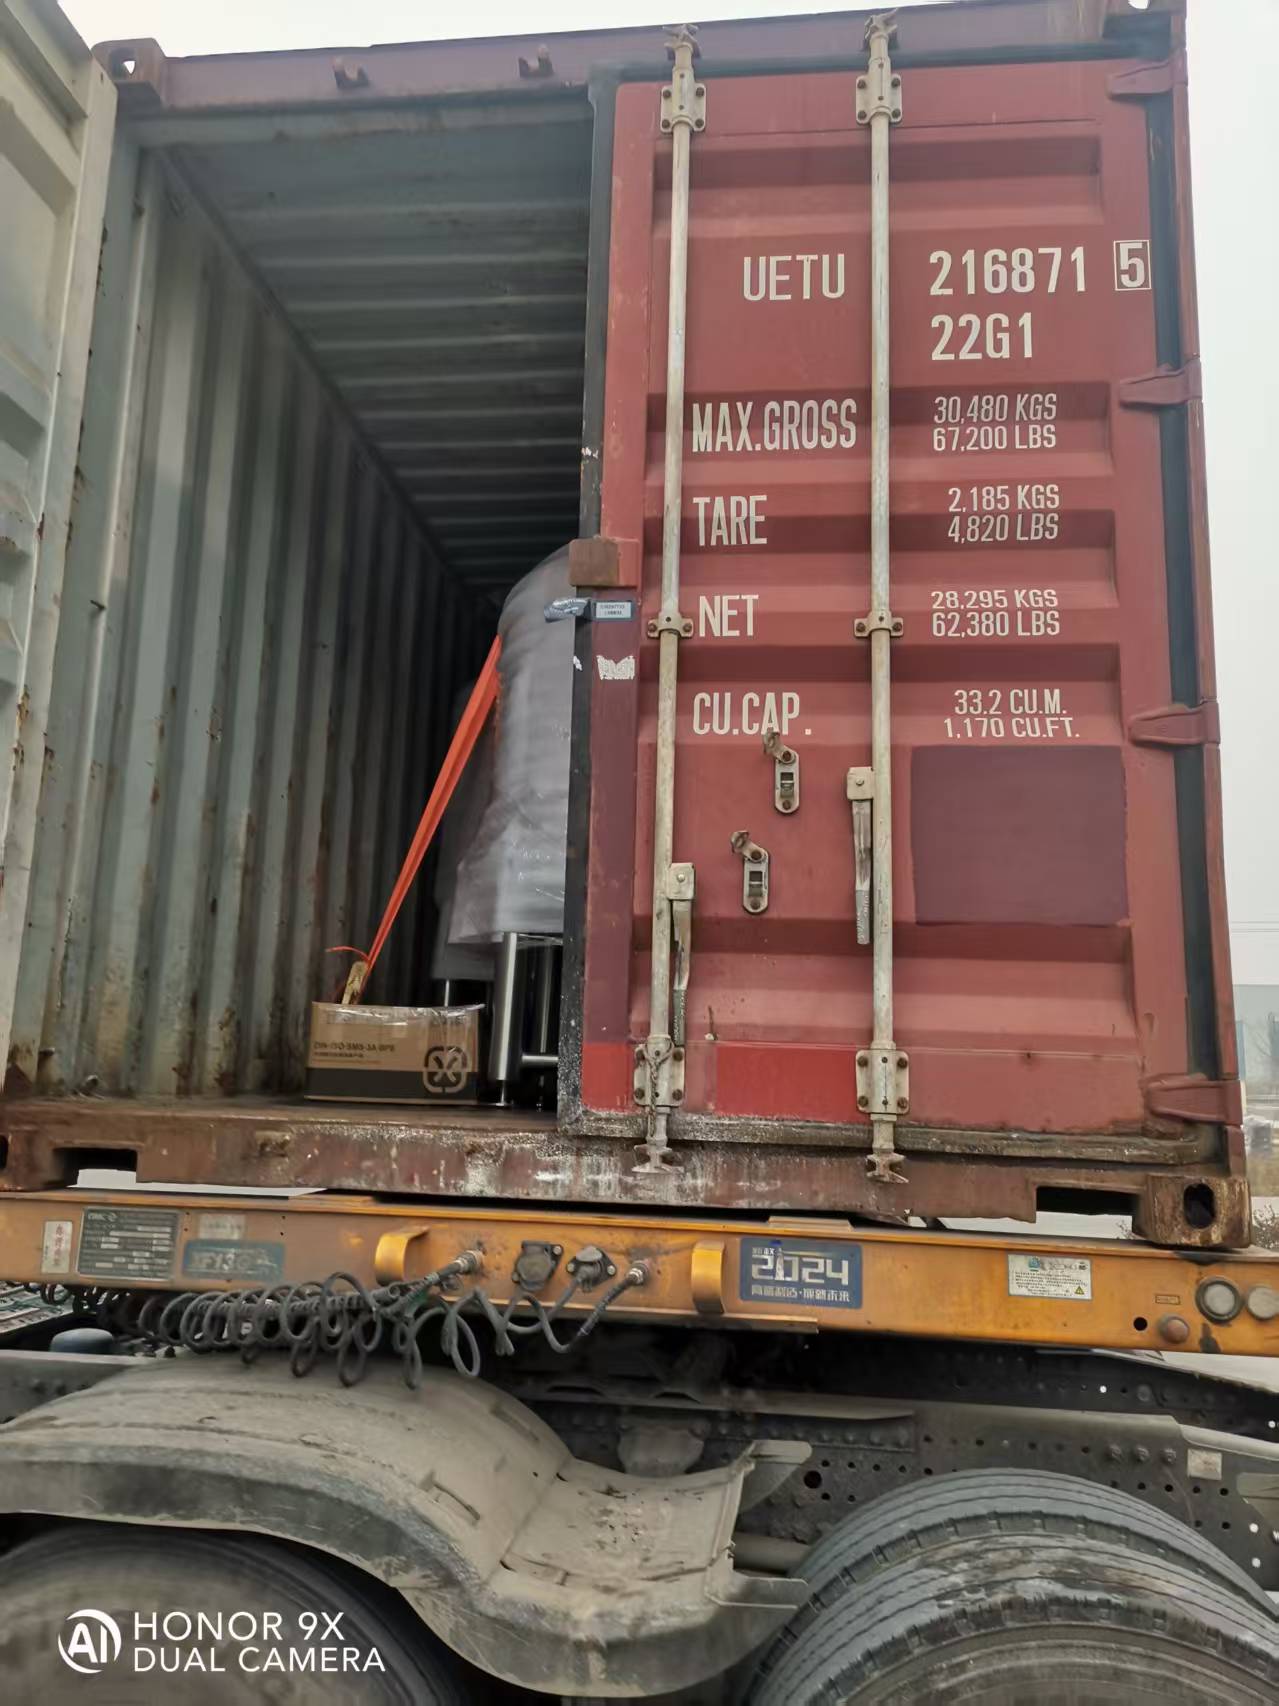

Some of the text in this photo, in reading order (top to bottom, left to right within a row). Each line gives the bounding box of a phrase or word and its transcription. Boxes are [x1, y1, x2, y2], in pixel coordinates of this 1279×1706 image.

[743, 243, 1145, 300] UETU 216871 5
[931, 313, 1032, 361] 22G1
[692, 394, 1057, 452] MAX.GROSS 30,480 KGS
[933, 425, 1056, 451] 67,200 LBS
[693, 495, 767, 546] TARE
[1017, 485, 1060, 509] KGS
[948, 513, 1058, 544] 4,820 LBS
[699, 594, 759, 637] NET
[1014, 589, 1058, 607] KGS
[932, 610, 1060, 638] 62,380 LBS
[1009, 689, 1067, 714] CU.M.
[1011, 718, 1080, 738] CU.FT.
[751, 1254, 849, 1286] 2024
